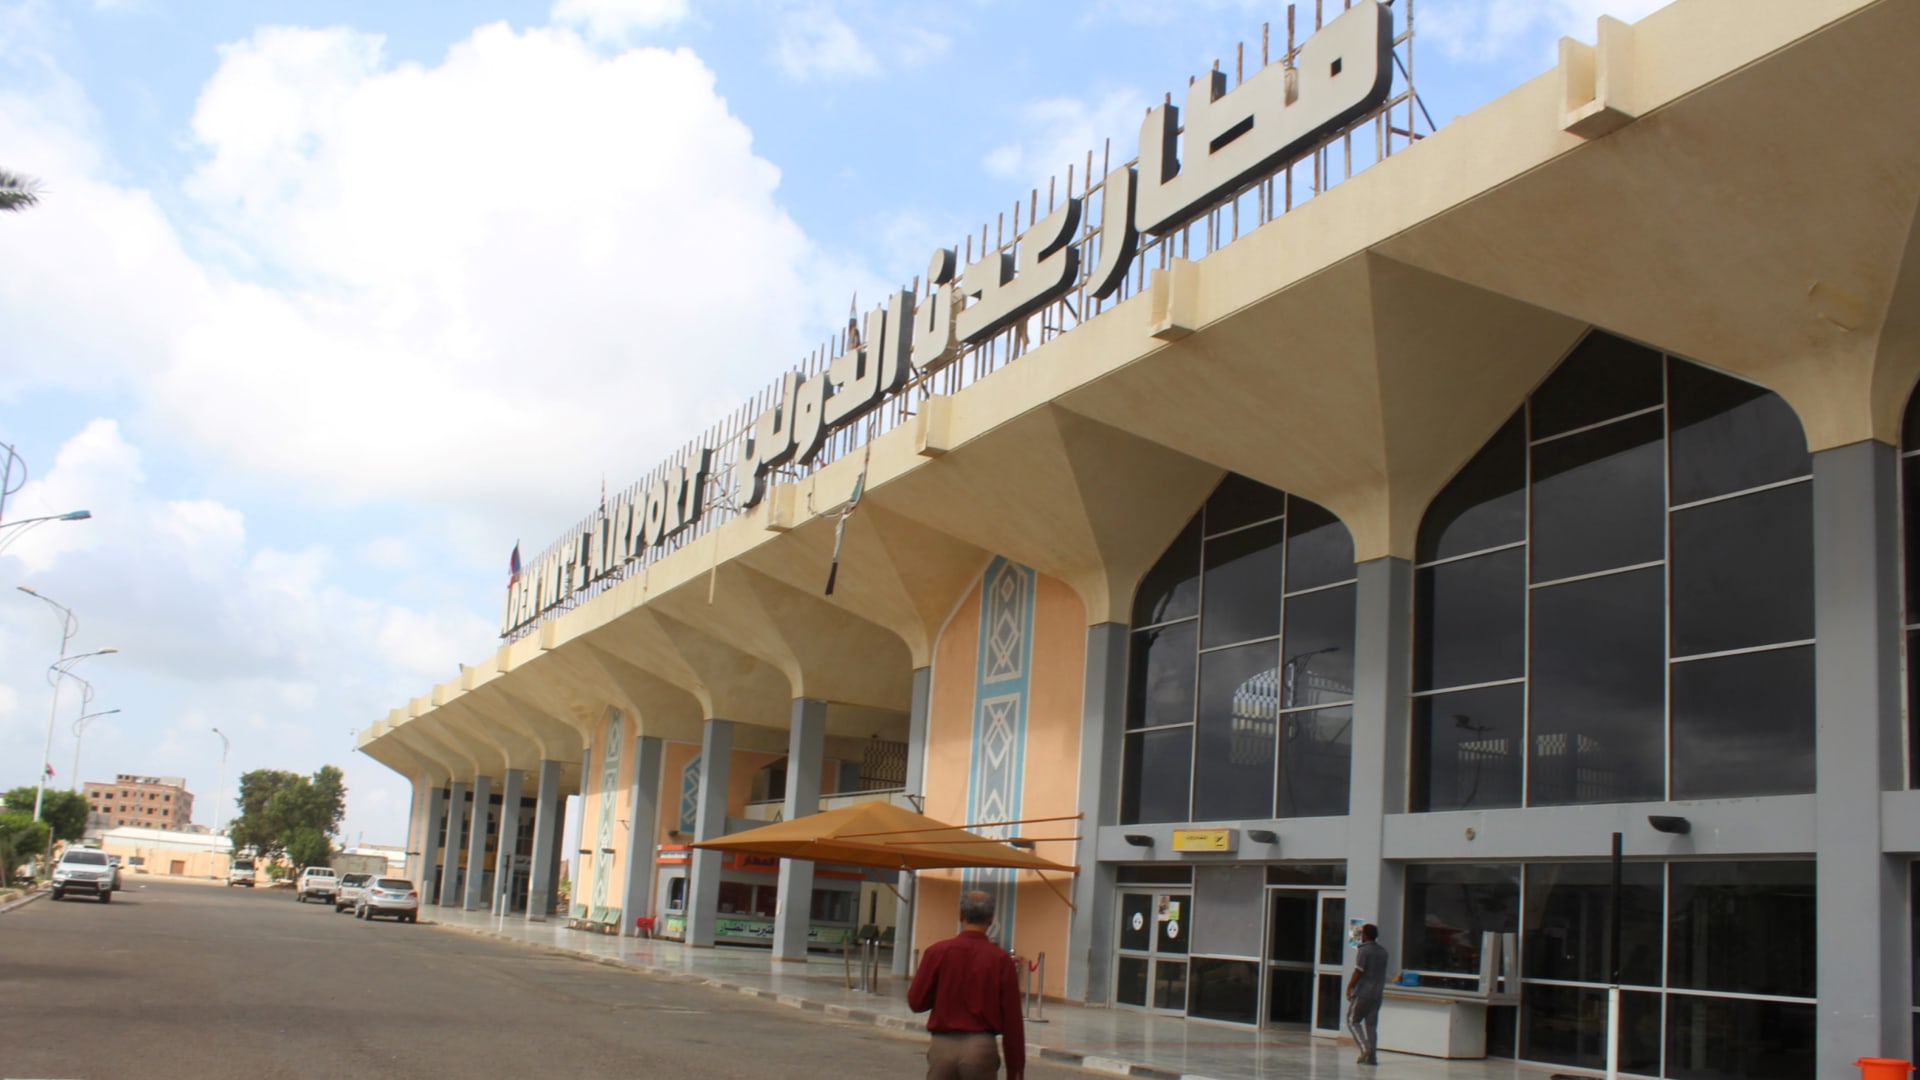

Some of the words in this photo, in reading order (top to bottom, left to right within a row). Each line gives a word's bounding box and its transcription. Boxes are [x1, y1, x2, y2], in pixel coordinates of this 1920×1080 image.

[1086, 0, 1394, 300] مطار
[911, 197, 1082, 369] عدن
[589, 448, 712, 581] AIRPORT
